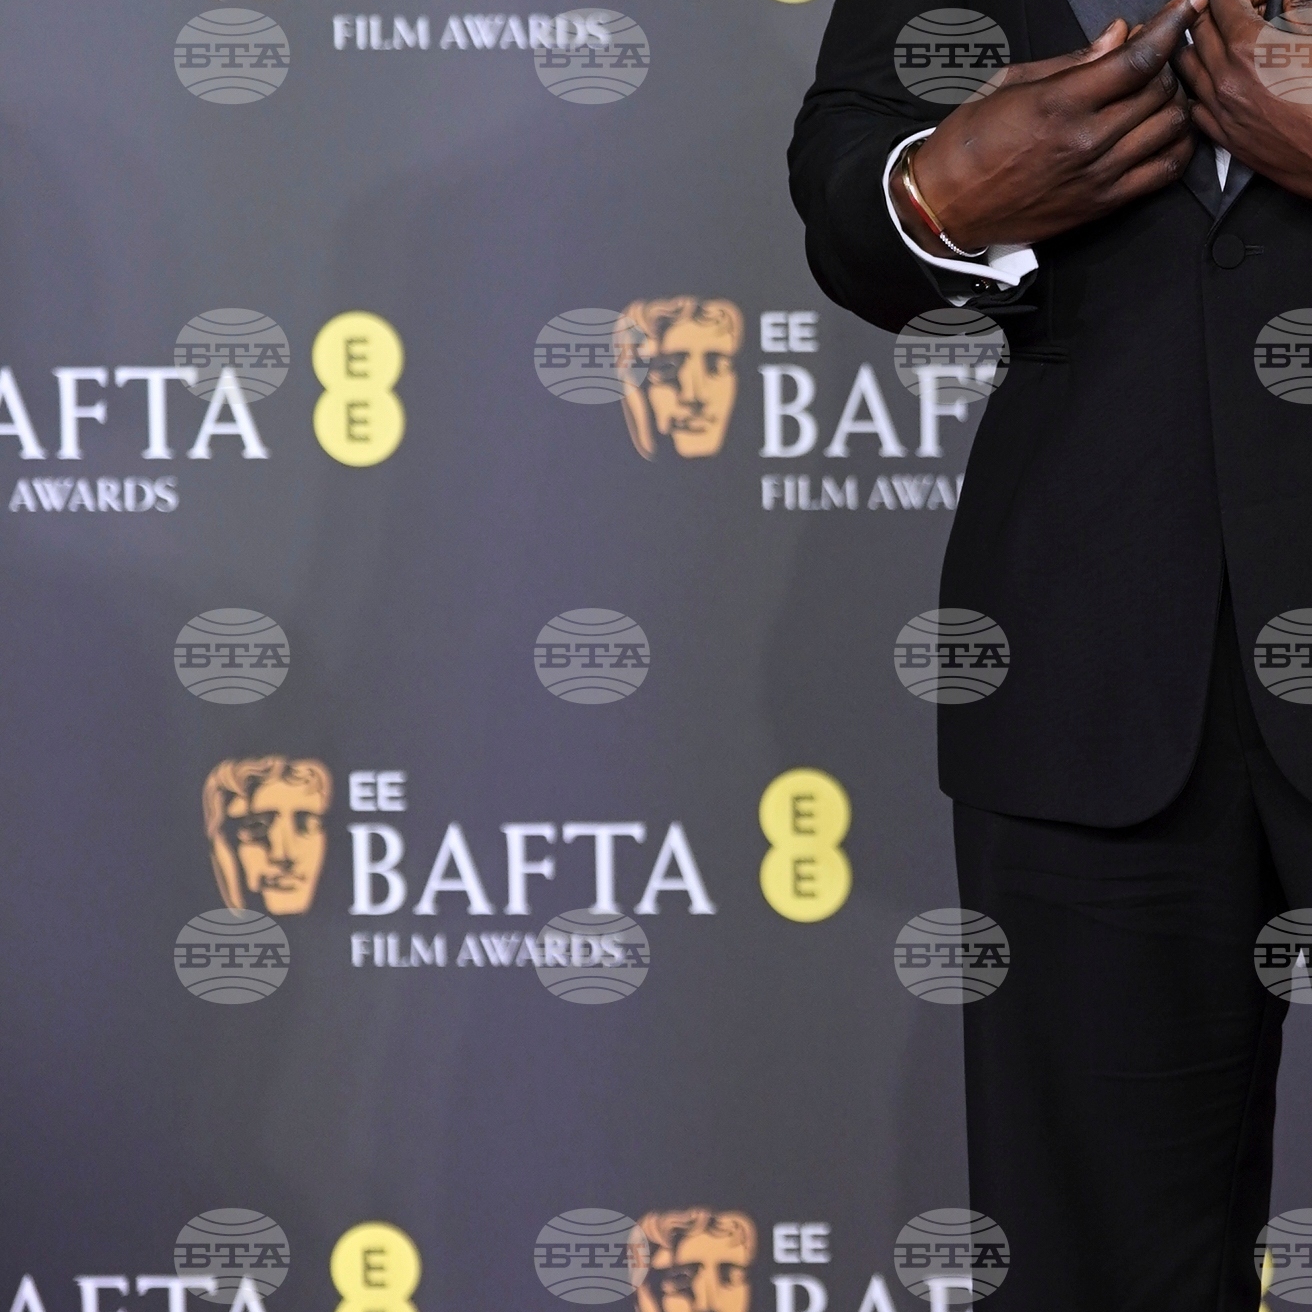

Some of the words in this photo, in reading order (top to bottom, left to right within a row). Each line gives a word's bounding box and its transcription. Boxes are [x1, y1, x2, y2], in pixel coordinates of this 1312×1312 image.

[333, 15, 430, 50] FILM
[441, 14, 610, 50] AWARDS
[760, 312, 817, 352] EE
[758, 362, 996, 457] BAF
[10, 478, 178, 512] AWARDS
[761, 475, 858, 510] FILM
[867, 474, 964, 510] AWA
[349, 771, 405, 811] EE
[349, 822, 714, 915] BAFTA
[351, 933, 446, 967] FILM
[456, 932, 623, 967] AWARDS
[773, 1223, 829, 1263] EE
